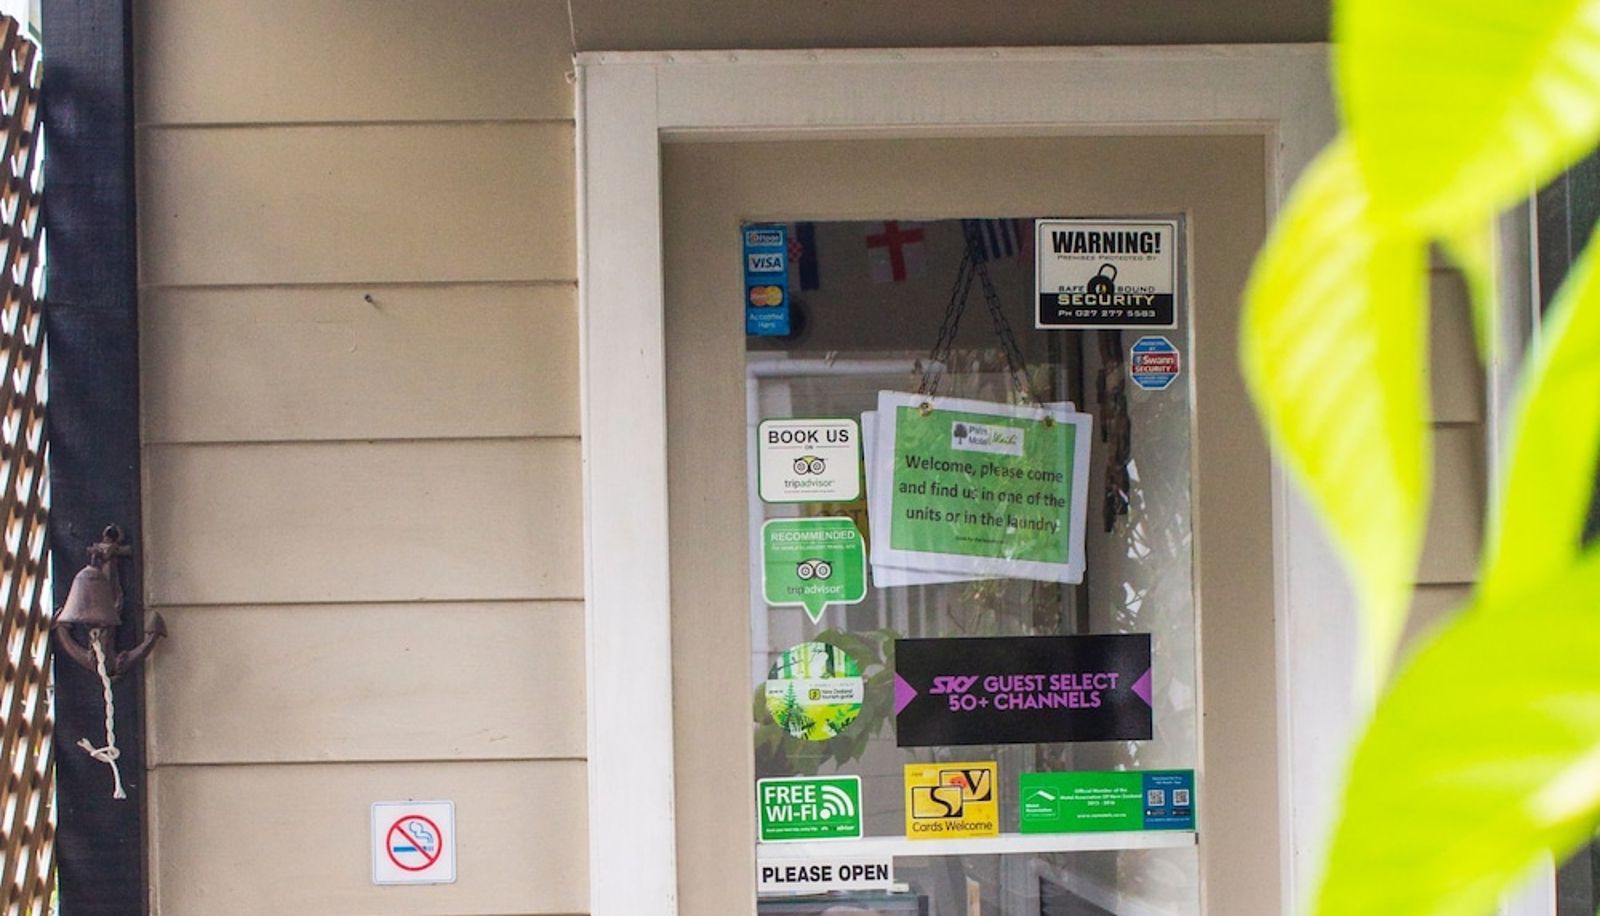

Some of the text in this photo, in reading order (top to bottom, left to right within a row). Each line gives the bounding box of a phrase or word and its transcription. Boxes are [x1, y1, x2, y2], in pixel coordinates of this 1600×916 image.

[1052, 231, 1161, 254] WARNING!
[751, 257, 782, 269] VISA
[1058, 294, 1155, 306] SECURITY
[768, 429, 849, 444] BOOK US
[905, 455, 1063, 483] Welcome, please come
[784, 479, 833, 489] tripadvisor
[899, 481, 1066, 508] and find us in one of the
[906, 506, 942, 521] units
[945, 511, 961, 523] or
[964, 510, 977, 524] in
[980, 512, 1003, 526] the
[770, 530, 855, 541] RECOMMENDED
[786, 585, 841, 595] tripadvisor
[929, 672, 1119, 694] SKY GUEST SELECT
[949, 691, 1102, 711] 50+ CHANNELS
[764, 785, 817, 804] FREE
[766, 804, 817, 822] WI-FI
[912, 820, 993, 832] Cards Welcome
[762, 864, 889, 883] PLEASE OPEN
